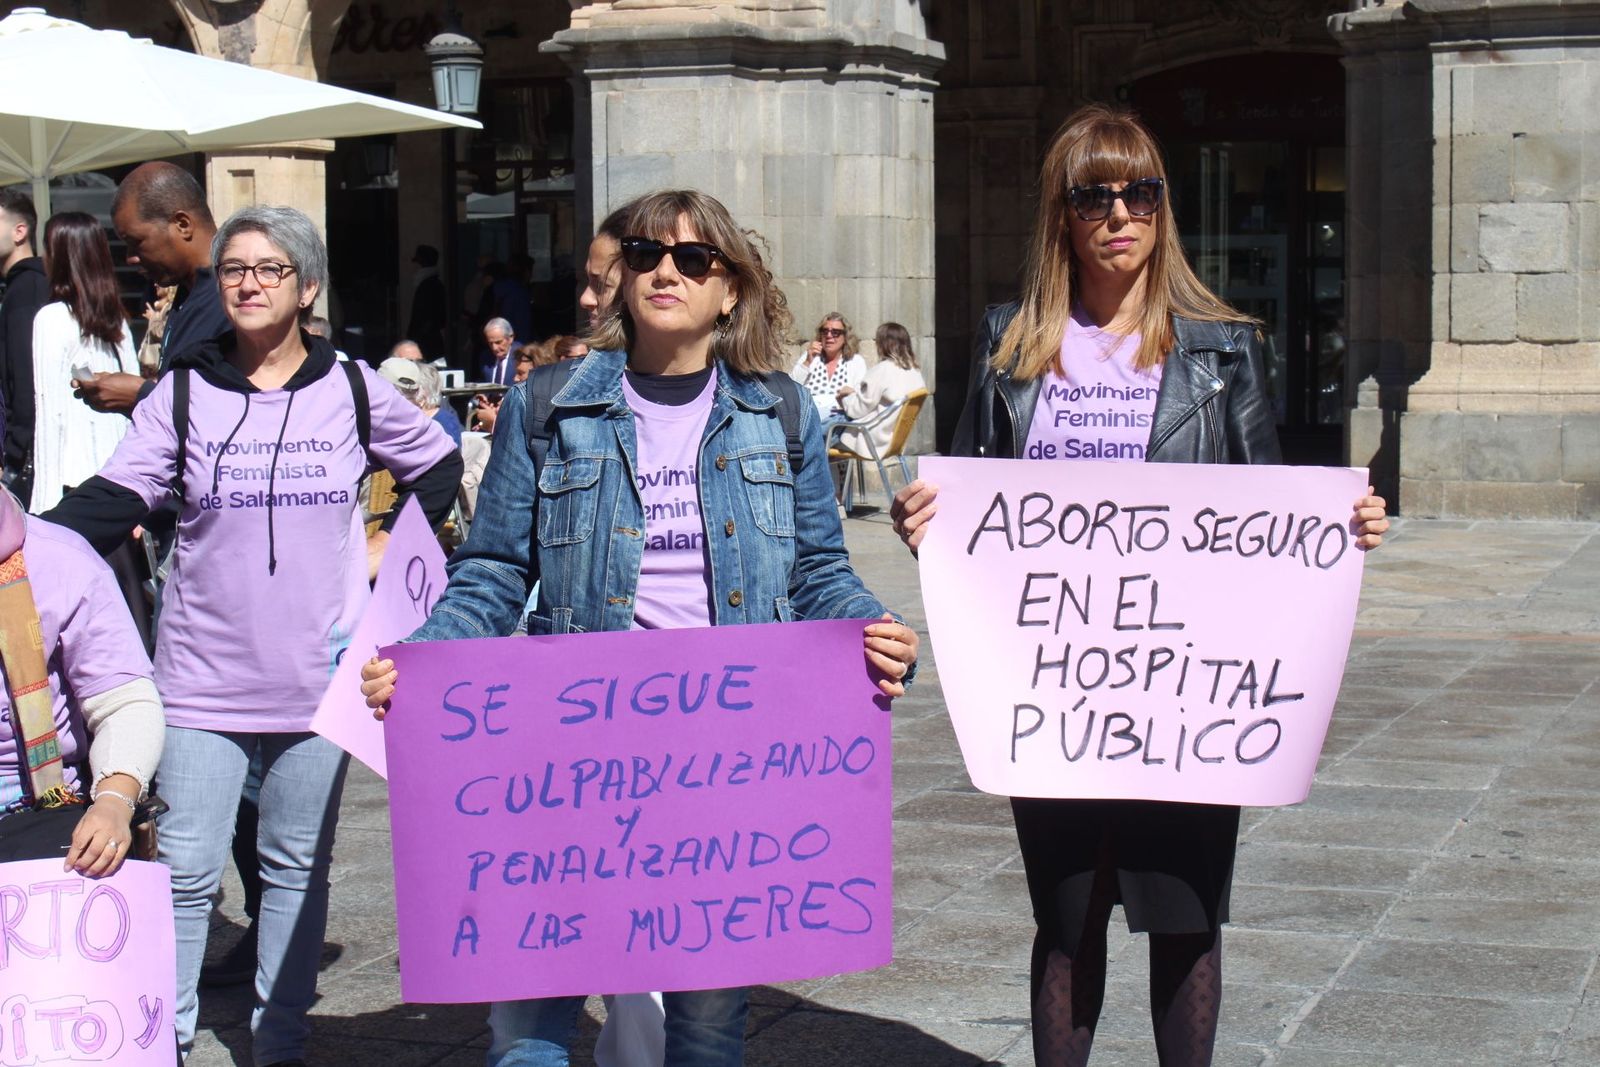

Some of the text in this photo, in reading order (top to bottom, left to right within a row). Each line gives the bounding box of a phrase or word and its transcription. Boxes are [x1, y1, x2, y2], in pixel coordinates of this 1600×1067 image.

[206, 438, 333, 456] Movimiento
[1029, 438, 1147, 460] de Salam
[1054, 408, 1153, 428] Feminis
[200, 490, 349, 510] de Salamanca
[218, 463, 327, 481] Feminista
[967, 492, 1348, 569] ABORTO SEGURO
[1017, 573, 1185, 635] EN EL
[440, 665, 757, 742] SE SIGUE
[455, 736, 875, 816] CULPABILIZANDO
[468, 823, 831, 892] PENALIZANDO
[452, 878, 876, 957] A LAS MUJERES
